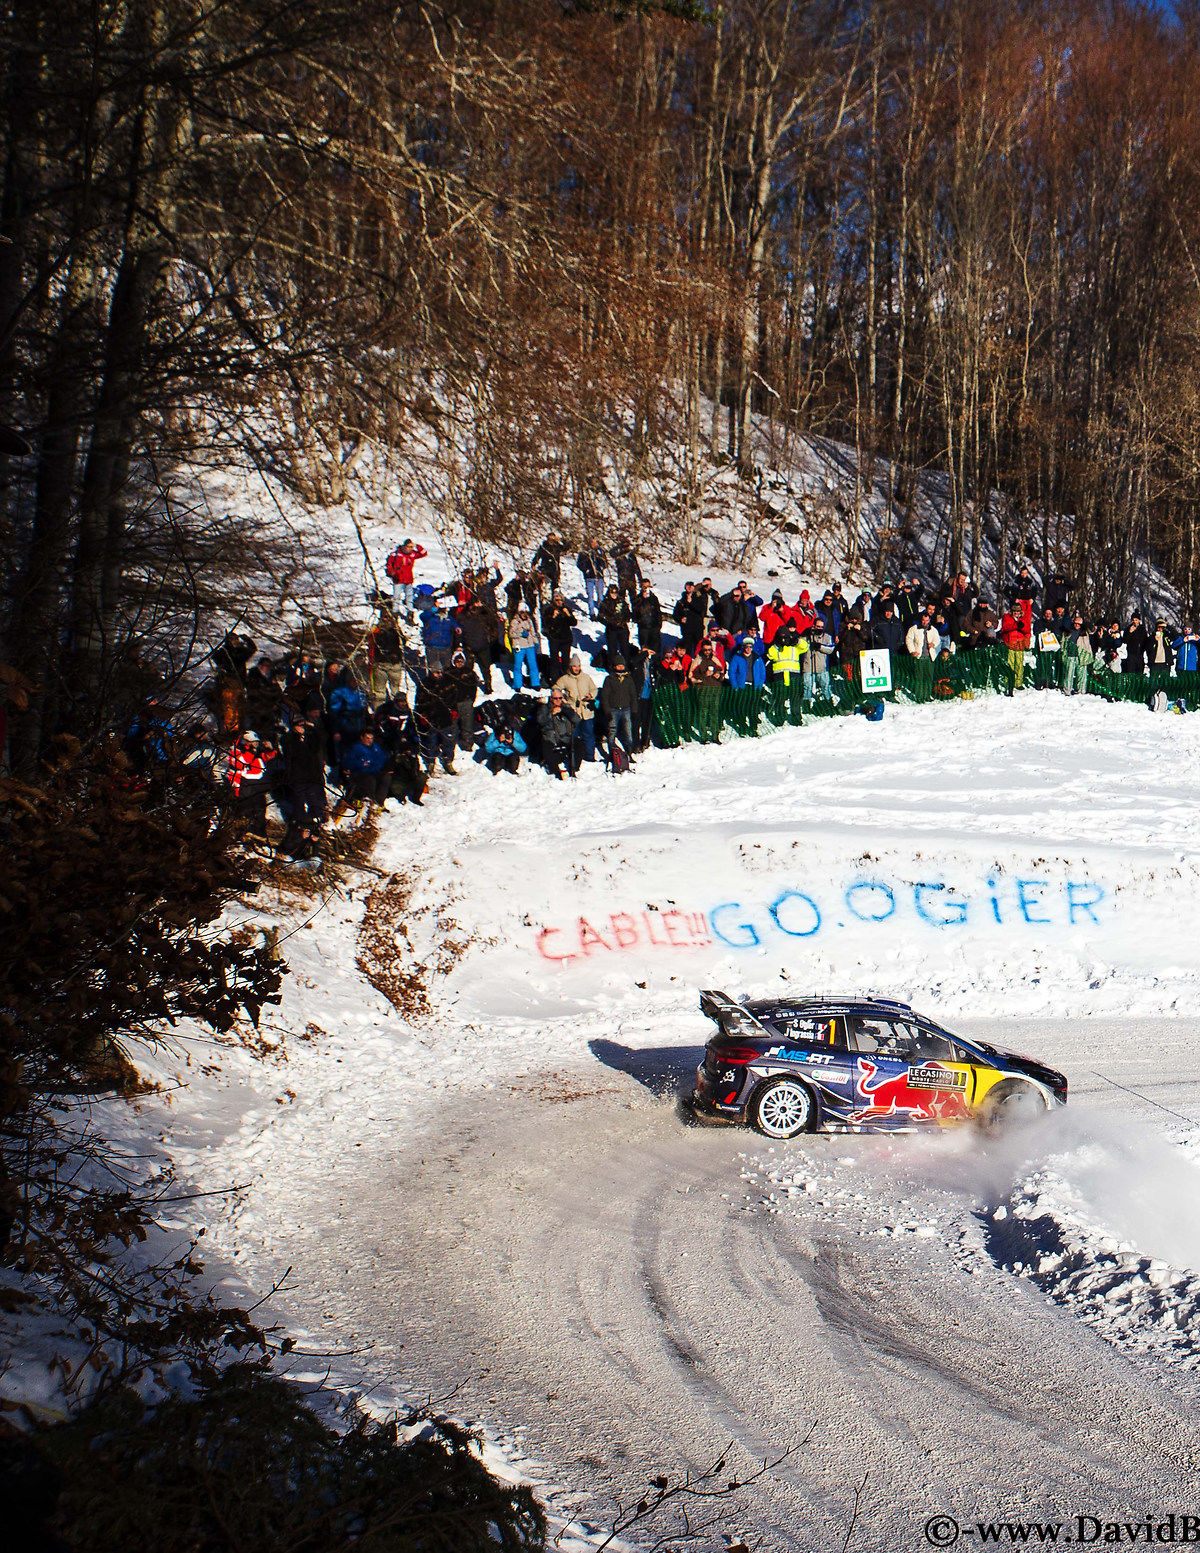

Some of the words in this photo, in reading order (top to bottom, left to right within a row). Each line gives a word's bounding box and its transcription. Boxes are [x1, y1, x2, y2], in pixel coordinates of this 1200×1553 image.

[828, 1019, 836, 1045] 1
[910, 1068, 919, 1077] LE
[920, 1069, 952, 1079] CASINO
[957, 1072, 963, 1086] 1
